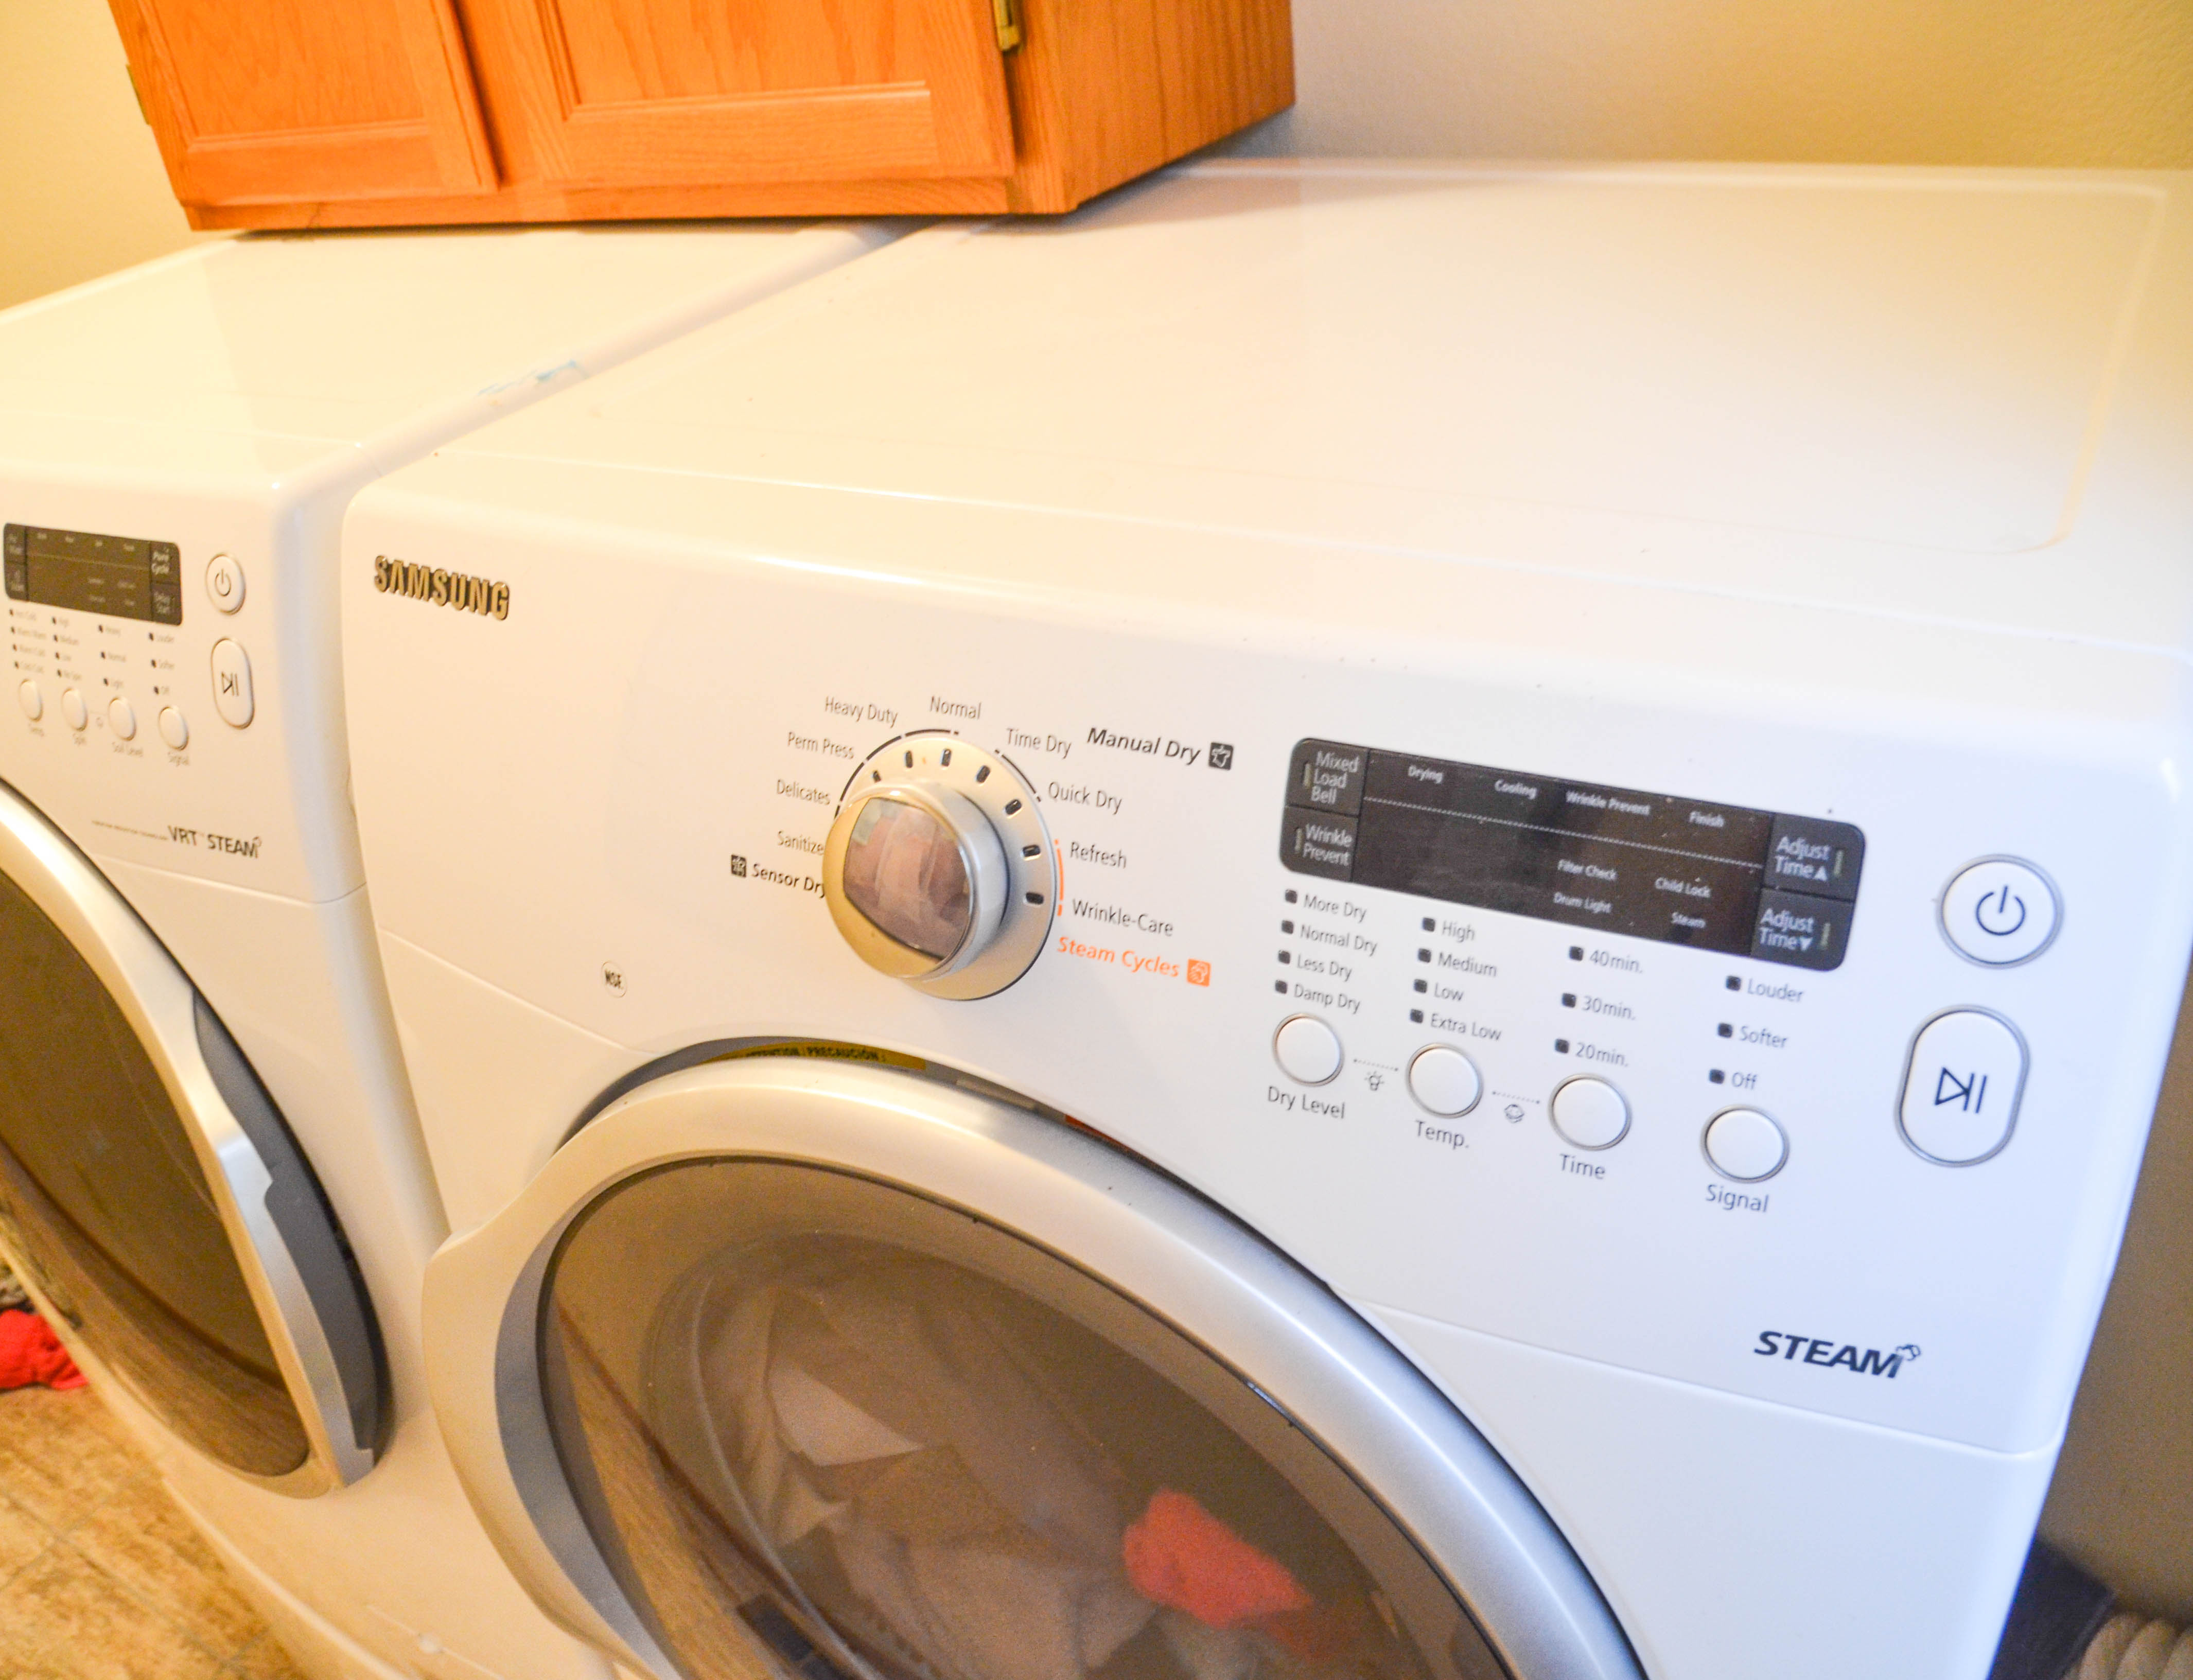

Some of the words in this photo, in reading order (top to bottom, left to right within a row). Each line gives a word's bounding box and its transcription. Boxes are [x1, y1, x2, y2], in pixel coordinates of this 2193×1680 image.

[374, 554, 510, 621] SAMSUNG
[824, 696, 864, 722] Heavy
[867, 704, 898, 726] Duty
[929, 695, 982, 720] Normal
[787, 731, 818, 753] Perm
[822, 738, 855, 761] Press
[1006, 728, 1042, 750] Time
[1046, 734, 1072, 759] Dry
[1086, 727, 1161, 755] Manual
[1165, 740, 1201, 766] Dry
[1315, 750, 1360, 773] Mixed
[1408, 764, 1444, 785] Drying
[776, 779, 831, 806] Delicates
[1313, 769, 1347, 790] Load
[1494, 779, 1538, 801] Cooling
[1048, 781, 1091, 805] Quick
[1095, 790, 1122, 815] Dry
[1310, 786, 1337, 806] Bell
[1565, 791, 1607, 810] Wrinkle
[1689, 811, 1726, 828] Finish
[206, 833, 259, 859] STEAM
[777, 830, 824, 856] Sanitize
[1304, 824, 1353, 848] Wrinkle
[1776, 835, 1831, 862] Adjust
[1070, 841, 1128, 869] Refresh
[1302, 842, 1351, 867] Prevent
[1774, 855, 1815, 880] Time
[751, 863, 801, 888] Sensor
[1585, 865, 1618, 882] Check
[1655, 877, 1683, 895] Child
[1685, 881, 1712, 899] Lock
[1072, 898, 1174, 937] Wrinkle-Care
[1304, 894, 1339, 915] More
[1343, 898, 1367, 923] Dry
[1583, 897, 1612, 915] Light
[1442, 920, 1476, 943] High
[1671, 912, 1707, 929] Steam
[1760, 907, 1815, 934] Adjust
[1300, 924, 1350, 948] Normal
[1355, 935, 1378, 957] Dry
[1759, 926, 1798, 950] Time
[1057, 936, 1115, 964] Steam
[1121, 950, 1180, 978] Cycles
[1297, 954, 1324, 974] Less
[1329, 961, 1353, 982] Dry
[1437, 951, 1498, 977] Medium
[1293, 983, 1334, 1007] Damp
[1338, 992, 1362, 1014] Dry
[1434, 982, 1464, 1002] Low
[1747, 978, 1804, 1003] Louder
[1430, 1013, 1467, 1035] Extra
[1471, 1021, 1503, 1041] Low
[1739, 1024, 1790, 1049] Softer
[1731, 1071, 1758, 1090] Off
[1267, 1085, 1296, 1111] Dry
[1301, 1093, 1346, 1119] Level
[1415, 1119, 1470, 1150] Temp.
[1558, 1152, 1607, 1180] Time
[1705, 1183, 1770, 1214] Signal
[1753, 1330, 1904, 1379] STEAM
